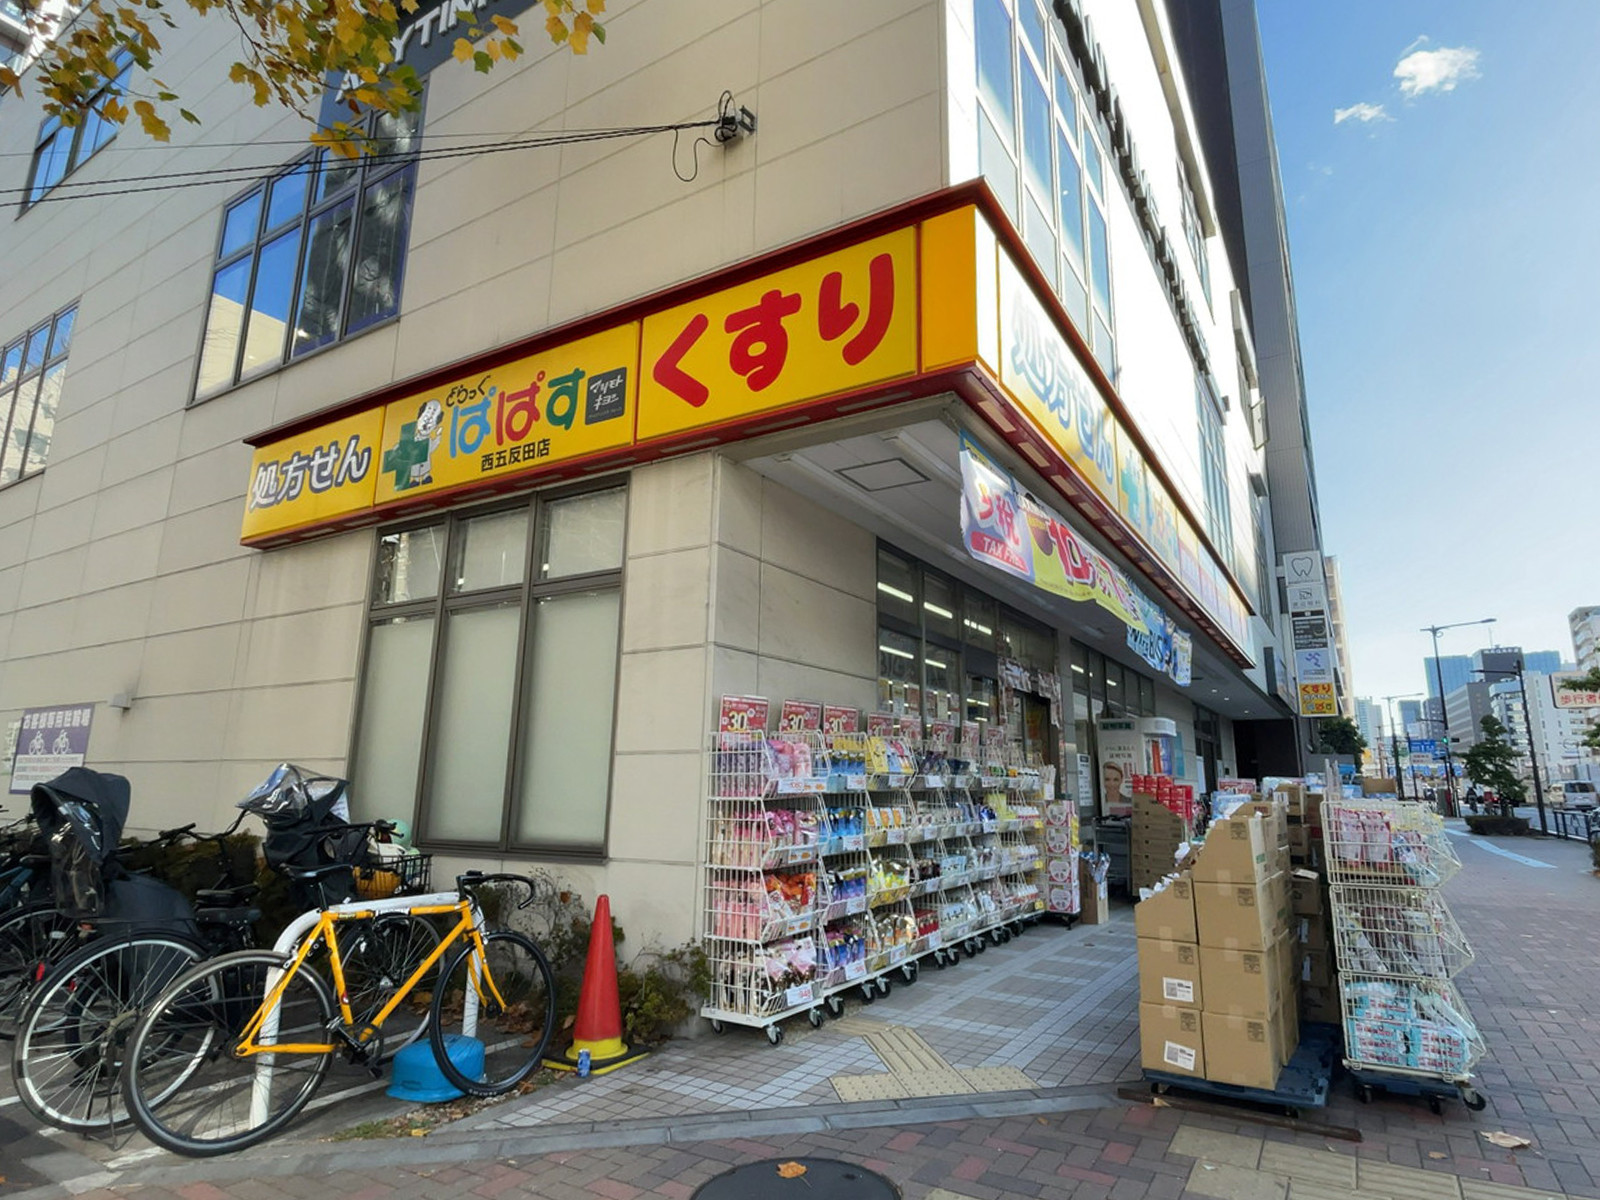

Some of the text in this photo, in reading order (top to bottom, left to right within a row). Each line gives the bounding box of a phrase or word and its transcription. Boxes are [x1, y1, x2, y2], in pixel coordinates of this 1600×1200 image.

[652, 253, 895, 408] くすり
[449, 368, 586, 458] ぱぱす
[481, 438, 551, 473] 西五反田店
[249, 434, 372, 512] 処方せん
[984, 537, 1004, 558] TAX
[1560, 693, 1600, 705] 歩行者
[728, 711, 748, 731] 30
[788, 714, 805, 731] 30
[829, 717, 842, 734] 30
